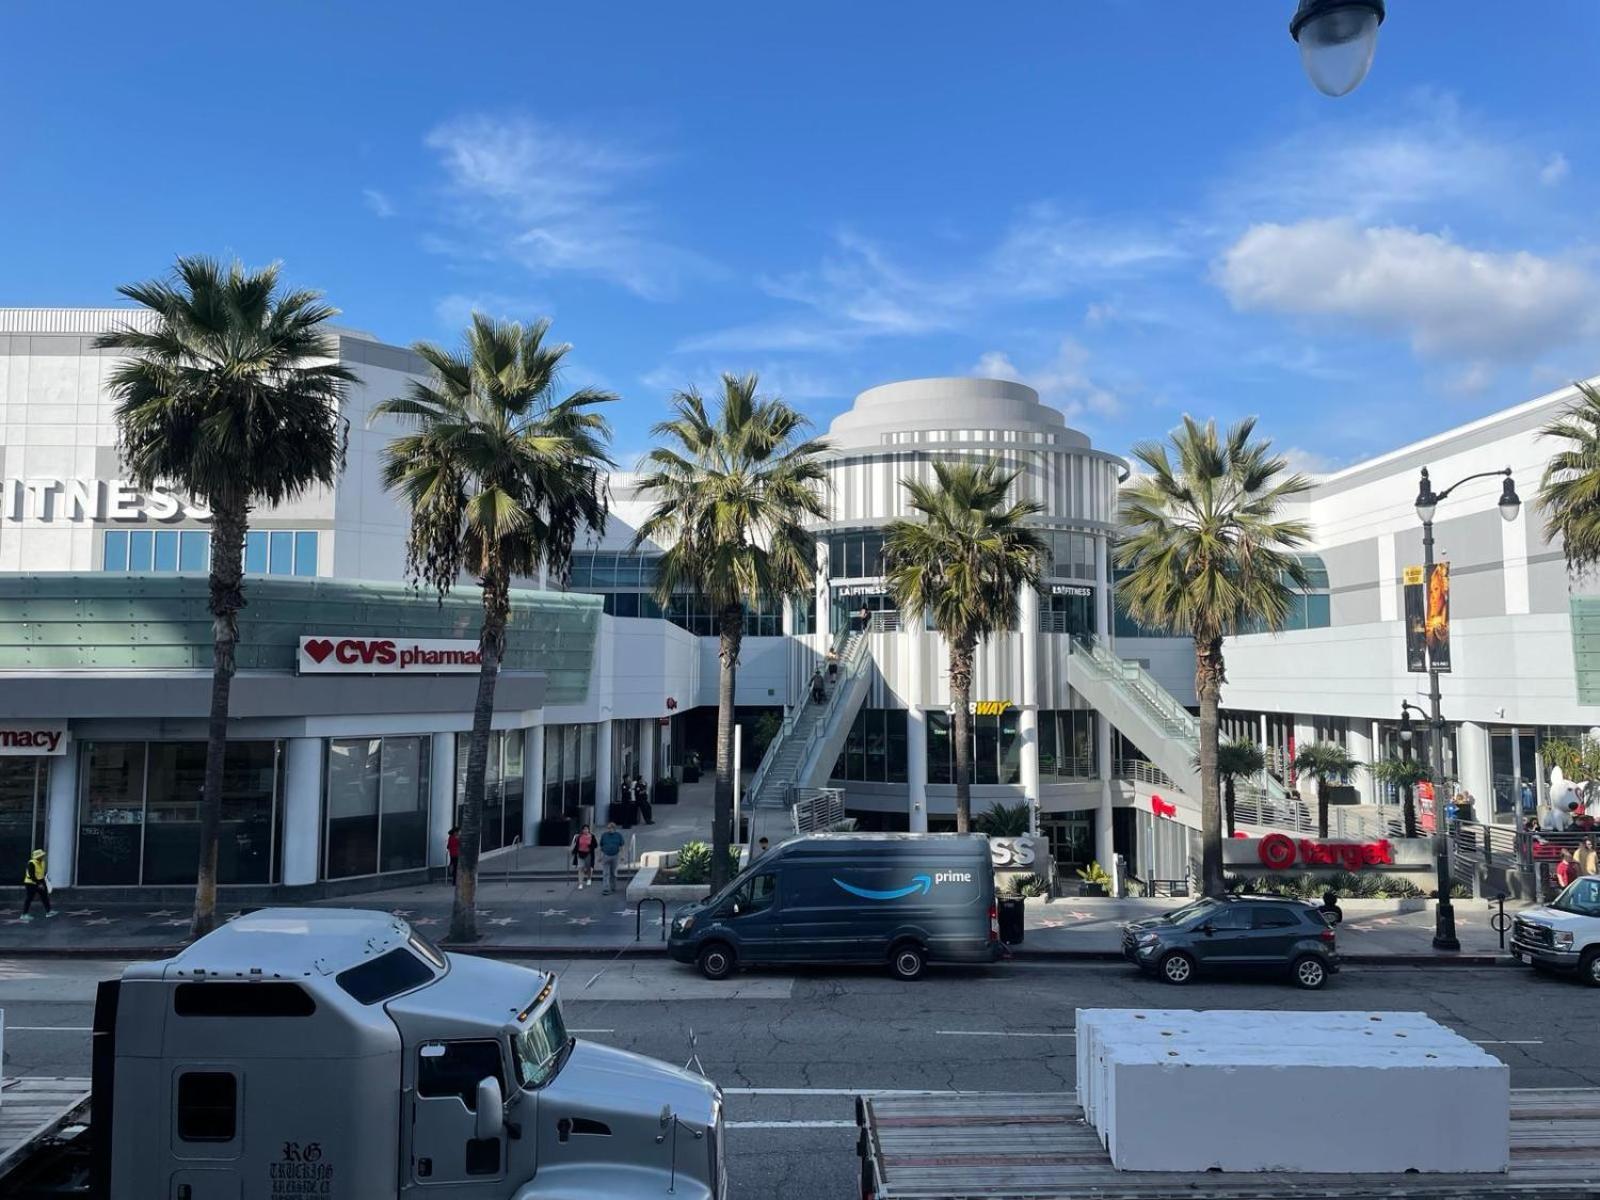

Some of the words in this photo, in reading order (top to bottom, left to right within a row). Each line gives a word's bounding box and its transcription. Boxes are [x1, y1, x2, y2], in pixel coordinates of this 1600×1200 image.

[335, 639, 397, 665] CVS
[945, 700, 1012, 715] SBWAY
[1299, 839, 1392, 872] target
[935, 870, 972, 884] prime
[283, 1141, 322, 1162] RG
